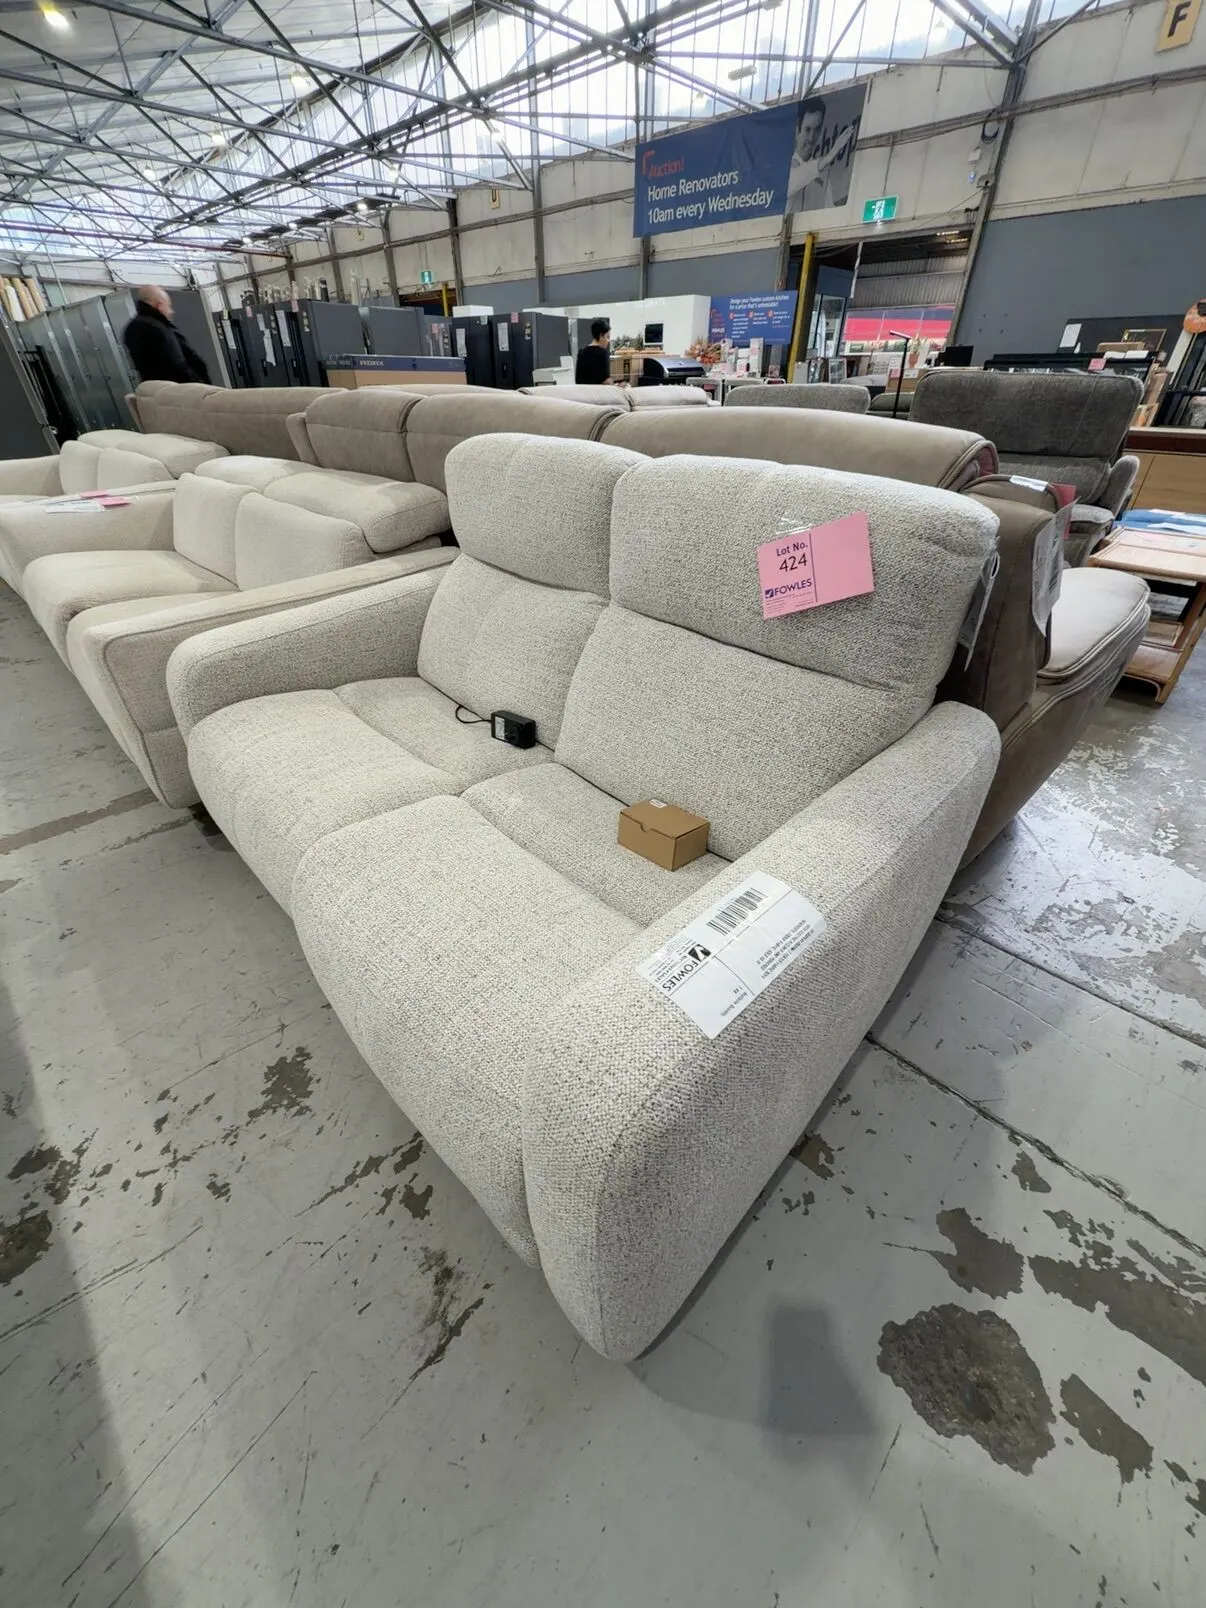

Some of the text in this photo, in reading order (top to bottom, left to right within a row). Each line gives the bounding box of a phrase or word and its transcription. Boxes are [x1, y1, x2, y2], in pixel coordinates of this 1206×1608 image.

[1168, 0, 1192, 38] F
[648, 170, 739, 202] Home Renovators
[648, 188, 774, 224] 10am every Wednesday
[776, 541, 808, 557] Lot No.
[779, 553, 808, 572] 424
[774, 578, 812, 596] FOWLES
[662, 960, 699, 992] FOWLES
